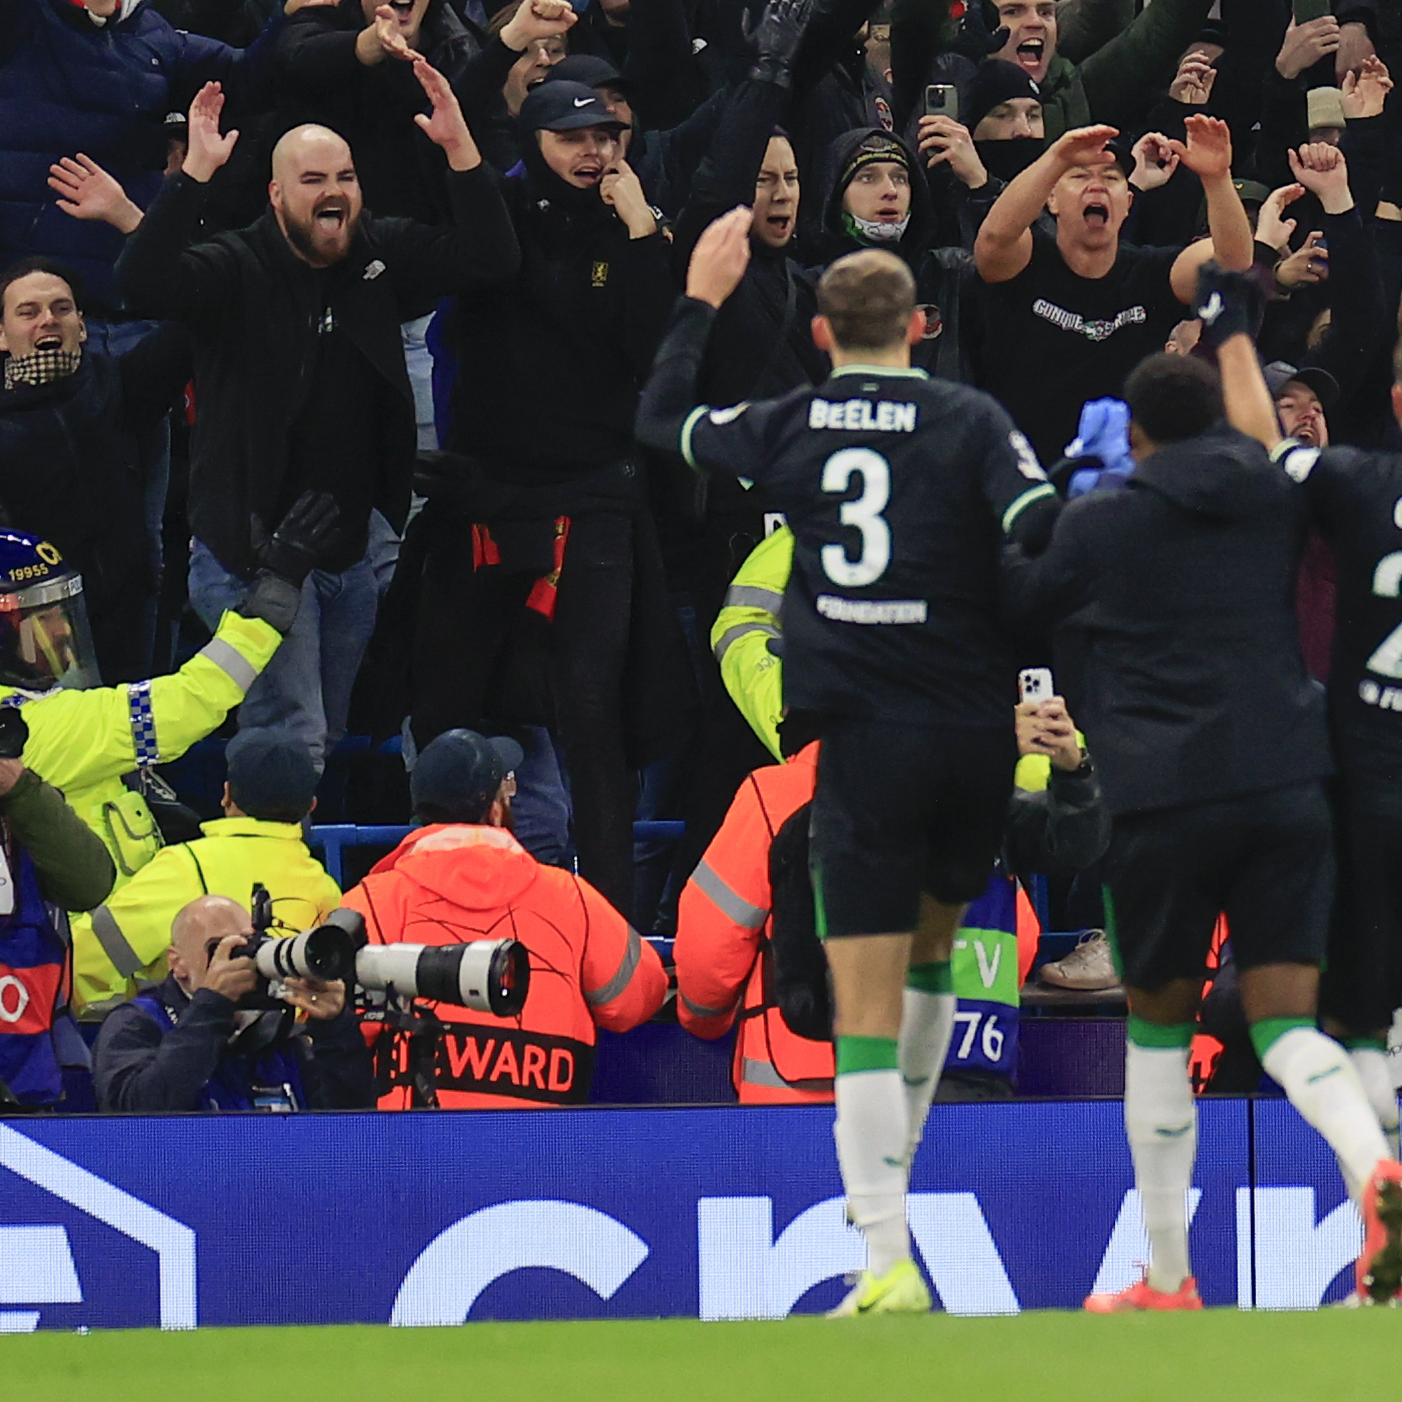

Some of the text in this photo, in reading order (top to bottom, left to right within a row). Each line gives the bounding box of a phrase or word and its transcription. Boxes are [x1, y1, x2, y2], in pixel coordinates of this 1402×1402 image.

[808, 397, 917, 432] BEELEN
[820, 446, 893, 588] 3
[8, 562, 50, 582] 19955
